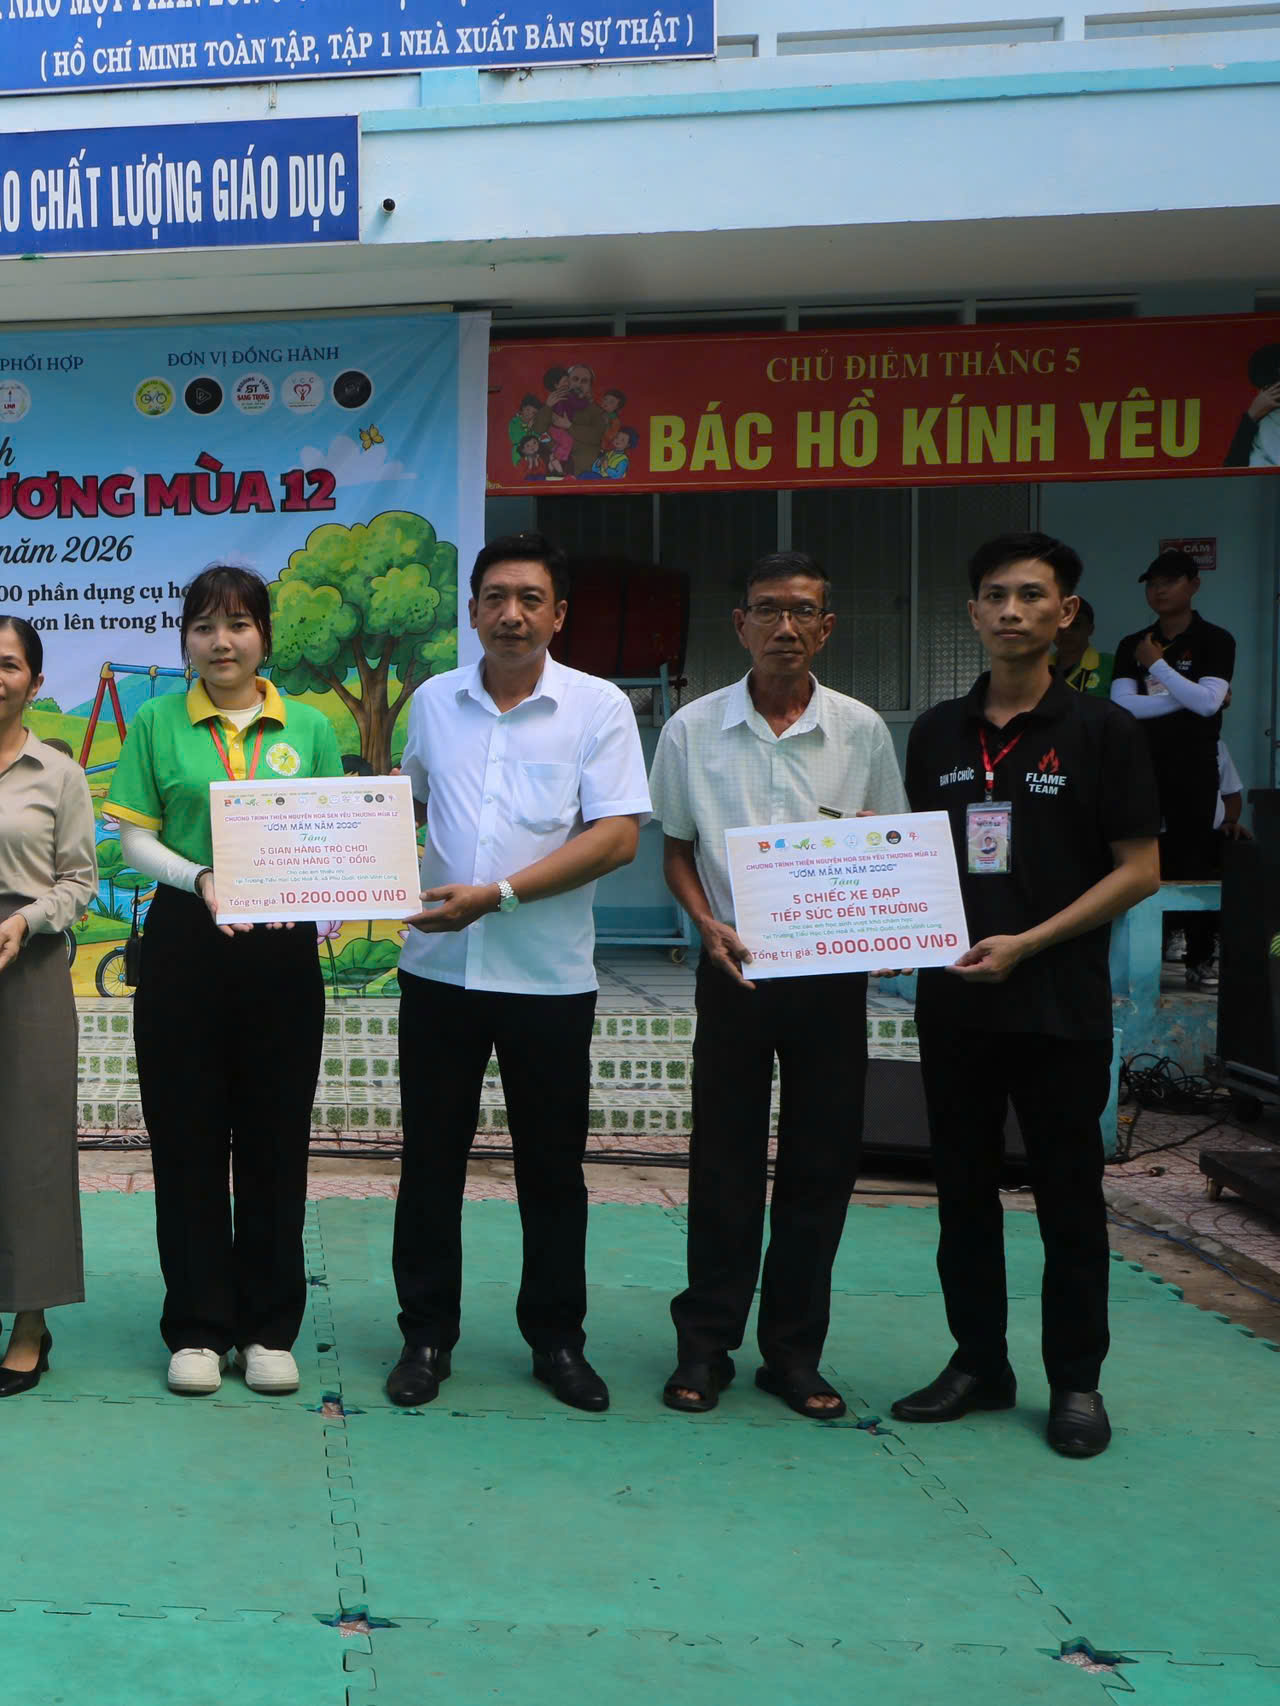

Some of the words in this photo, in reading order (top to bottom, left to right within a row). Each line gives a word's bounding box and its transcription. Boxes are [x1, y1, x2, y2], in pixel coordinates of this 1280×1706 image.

[53, 37, 85, 77] HỒ
[92, 40, 133, 73] CHÍ
[138, 42, 197, 71] MINH
[204, 33, 266, 67] TOÀN
[271, 30, 320, 69] TẬP,
[327, 26, 373, 66] TẬP
[381, 32, 392, 57] 1
[400, 21, 450, 56] NHÀ
[456, 13, 518, 53] XUẤT
[525, 14, 574, 50] BẢN
[580, 17, 613, 54] SỰ
[616, 10, 680, 51] THẬT
[29, 147, 101, 232] CHẤT
[111, 151, 203, 240] LƯỢNG
[212, 144, 279, 223] GIÁO
[288, 151, 345, 233] DỤC
[0, 353, 42, 371] PHỐI
[47, 355, 84, 372] HỢP
[167, 350, 205, 366] ĐƠN
[210, 351, 226, 367] VỊ
[287, 346, 339, 361] HÀNH
[766, 348, 835, 384] CHỦ
[844, 342, 930, 381] ĐIỂM
[939, 347, 1056, 378] THÁNG
[1065, 348, 1081, 373] 5
[649, 403, 772, 473] BÁC
[795, 390, 878, 470] HỒ
[901, 393, 1056, 465] KÍNH
[1079, 387, 1202, 460] YÊU
[144, 451, 276, 517] MÙA
[280, 468, 337, 512] 12
[61, 535, 133, 563] 2026
[27, 581, 79, 607] phần
[83, 583, 135, 605] dụng
[139, 587, 163, 603] cụ
[64, 613, 95, 631] lên
[100, 615, 157, 634] trong
[1025, 772, 1067, 786] FLAME
[1029, 783, 1059, 795] TEAM
[280, 890, 368, 905] 10.200.000
[372, 889, 407, 902] VNĐ
[793, 895, 801, 905] 5
[805, 889, 847, 904] CHIẾC
[850, 889, 869, 900] XE
[872, 887, 901, 900] ĐẠP
[771, 908, 802, 923] TIẾP
[806, 906, 833, 920] SỨC
[837, 904, 866, 918] ĐẾN
[870, 901, 928, 916] TRƯỜNG
[816, 936, 911, 955] 9.000.000
[916, 933, 958, 949] VNĐ
